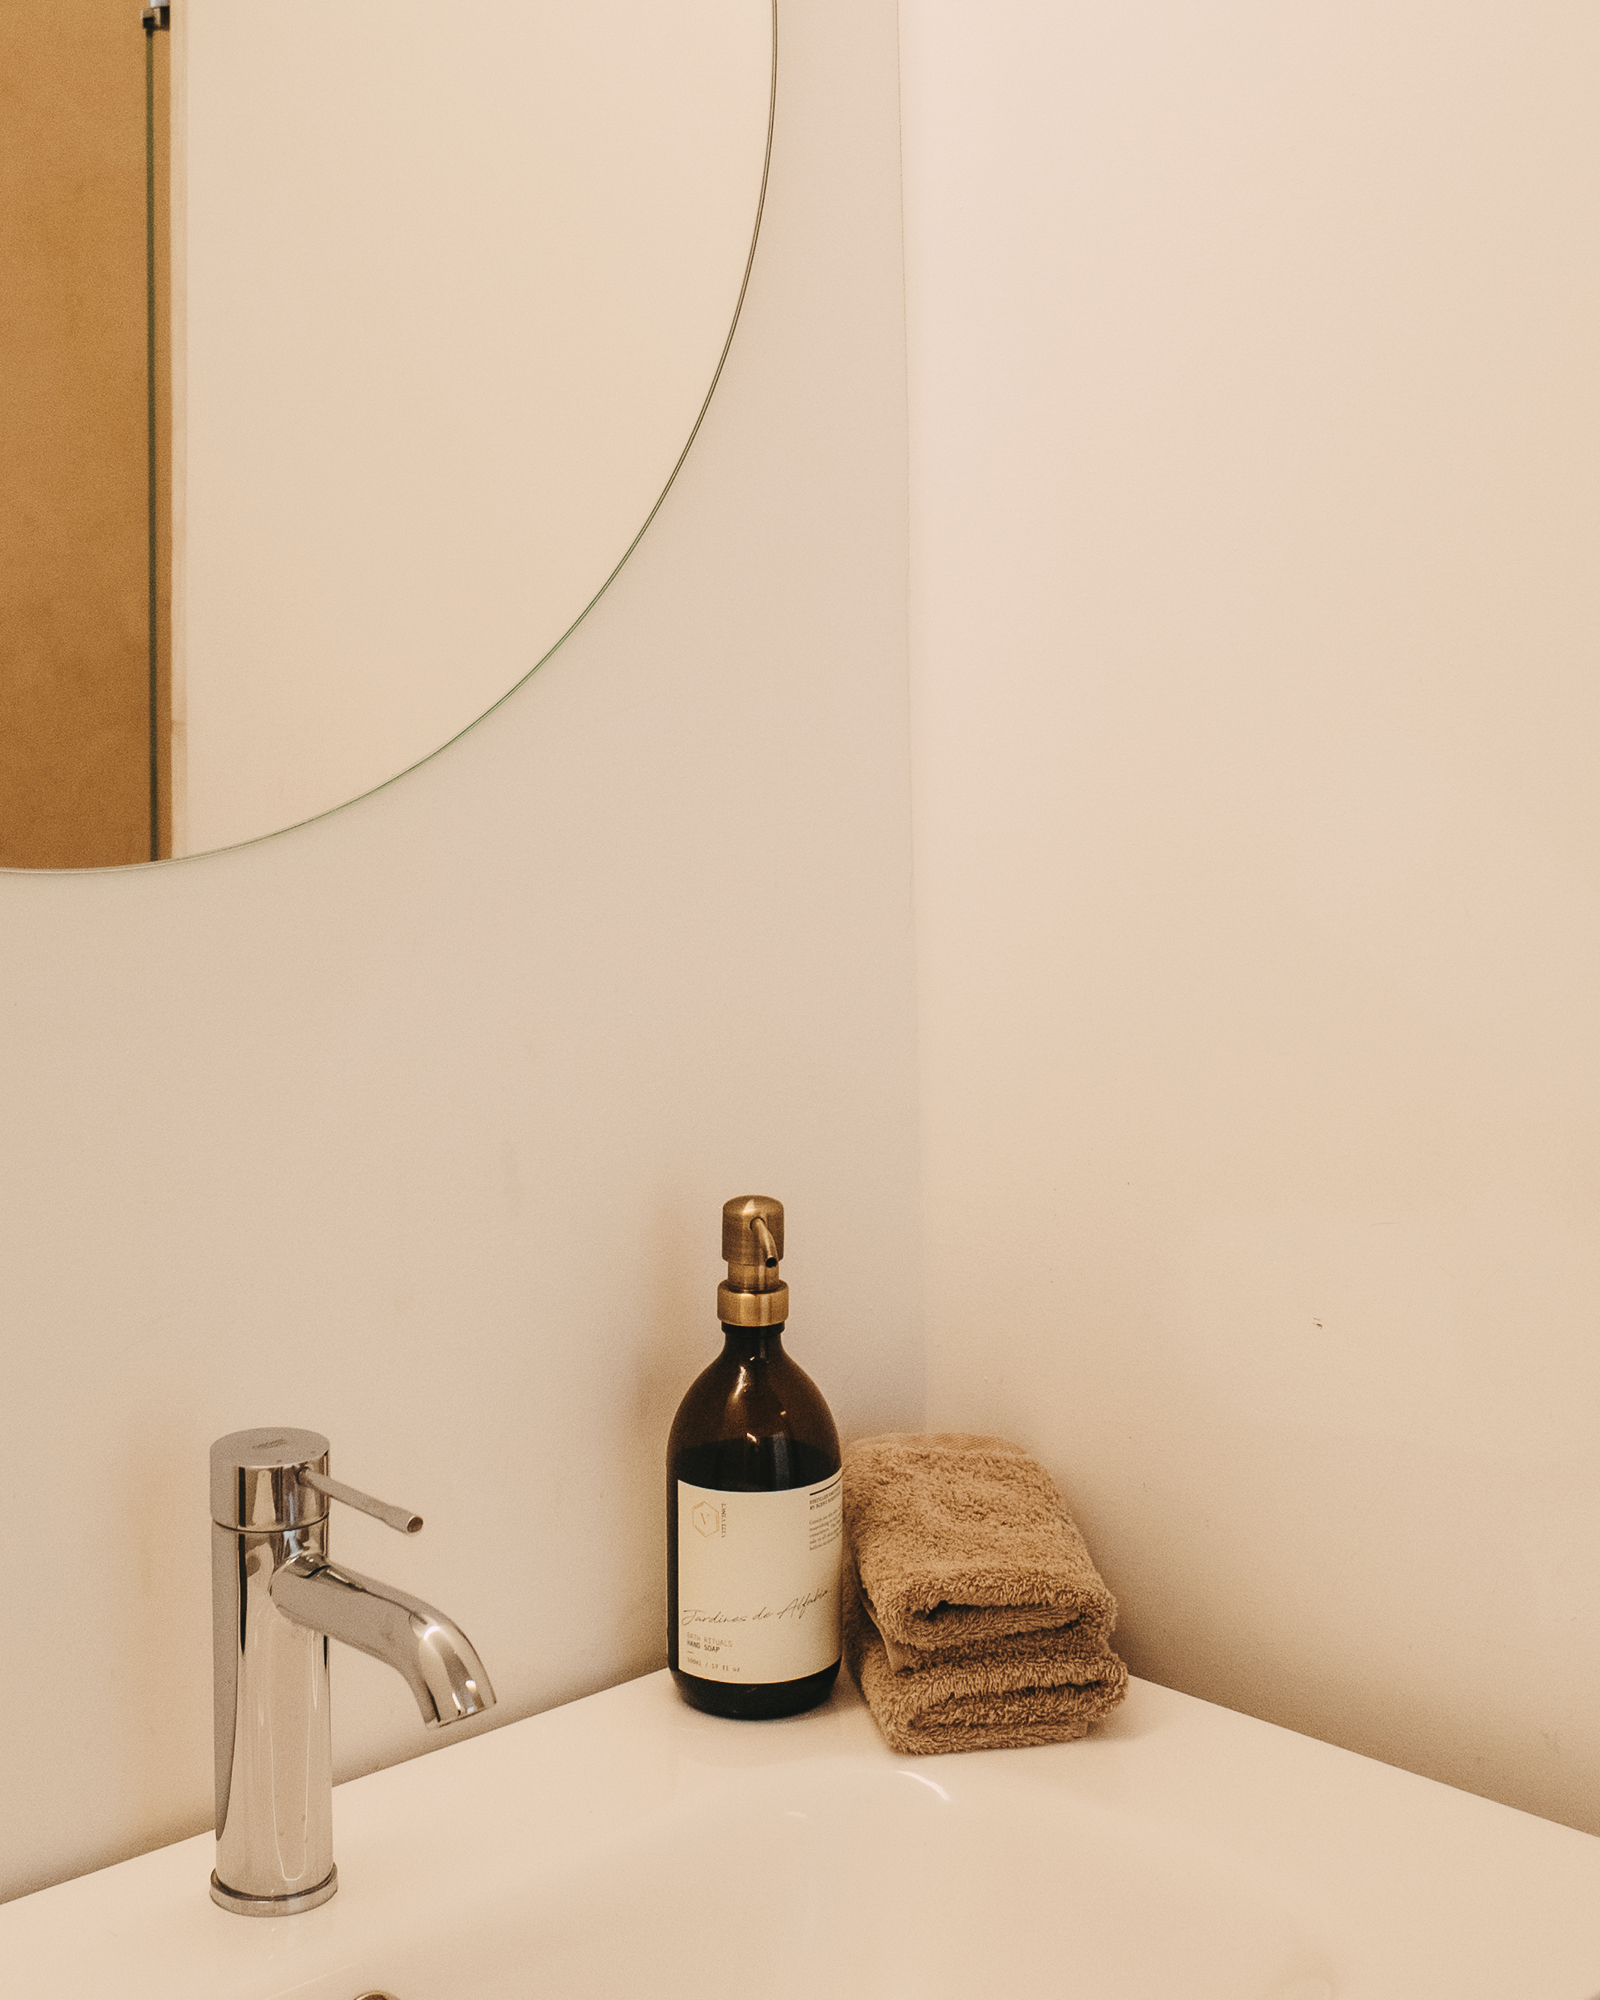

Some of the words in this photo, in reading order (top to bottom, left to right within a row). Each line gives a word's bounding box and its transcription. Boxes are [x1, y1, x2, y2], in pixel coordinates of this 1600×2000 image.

[681, 1609, 748, 1626] Jardines
[752, 1607, 774, 1621] de
[703, 1635, 733, 1648] RITUALS
[703, 1643, 720, 1653] SOAP
